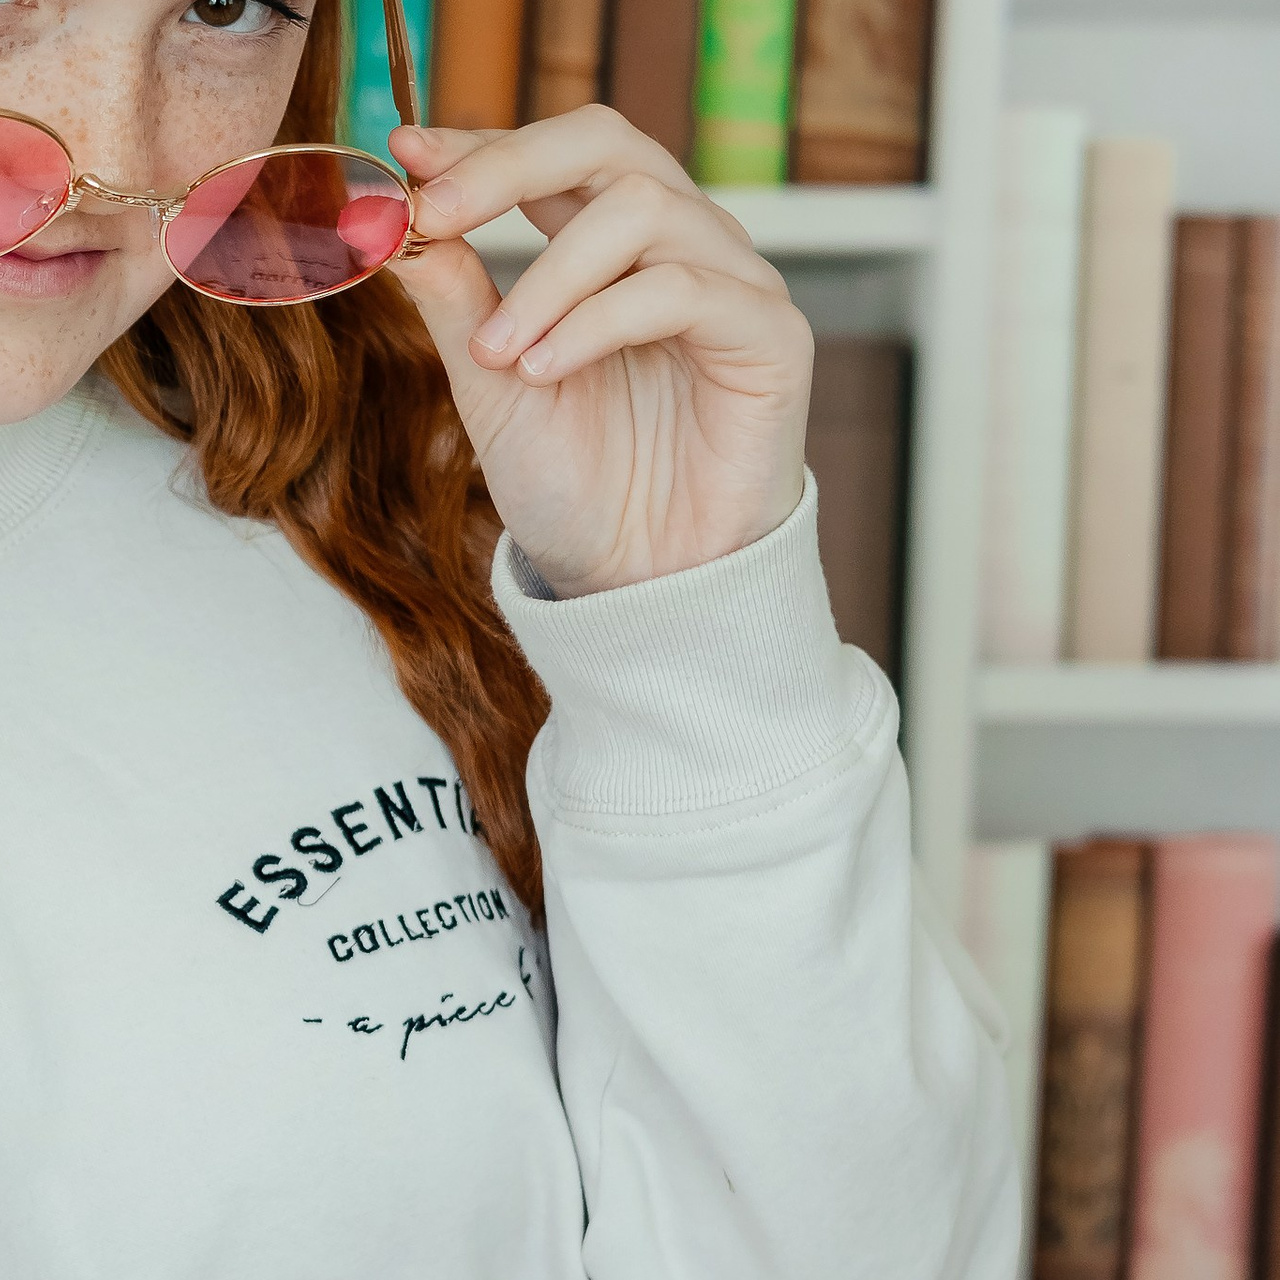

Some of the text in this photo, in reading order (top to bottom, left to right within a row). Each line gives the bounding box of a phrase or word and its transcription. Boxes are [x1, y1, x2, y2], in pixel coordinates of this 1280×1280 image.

[327, 888, 510, 962] COLLECTION
[347, 1016, 383, 1034] a
[400, 992, 516, 1060] piece
